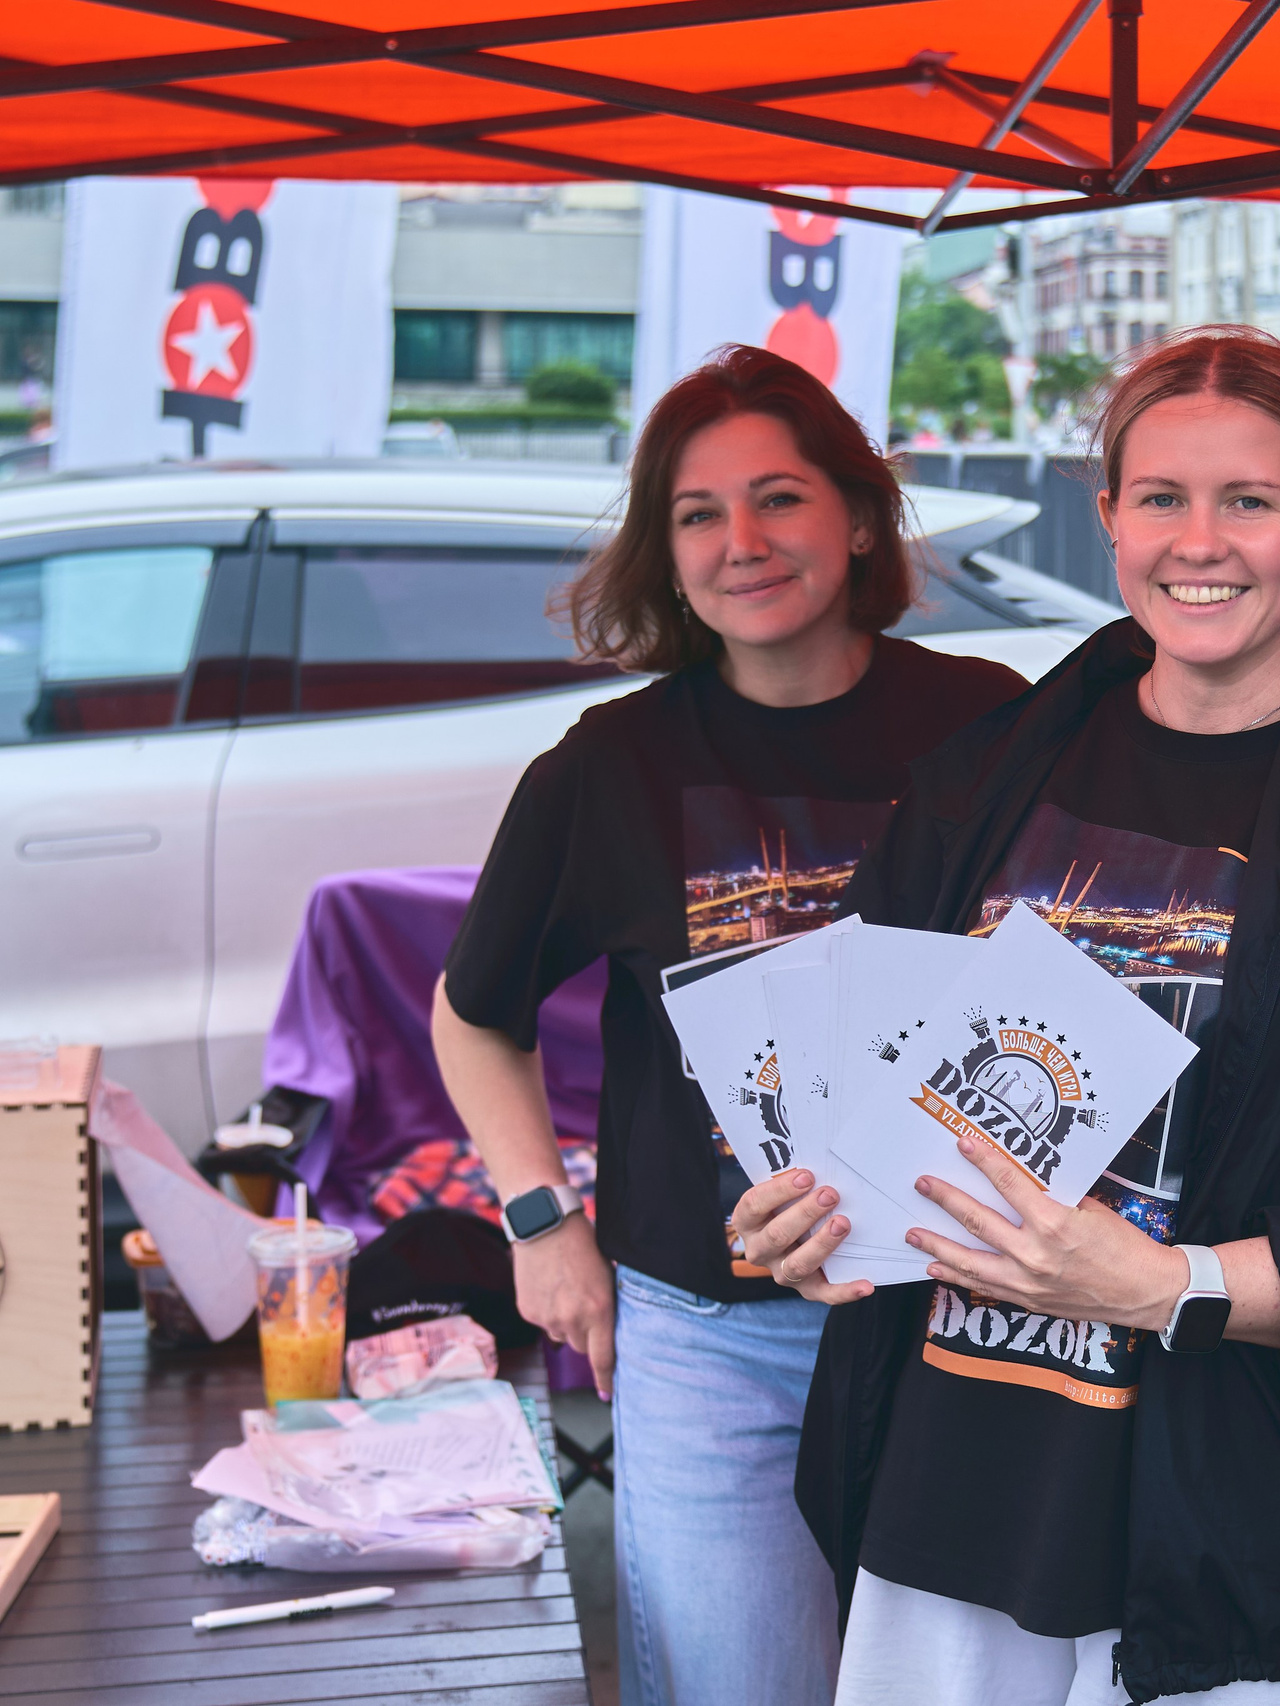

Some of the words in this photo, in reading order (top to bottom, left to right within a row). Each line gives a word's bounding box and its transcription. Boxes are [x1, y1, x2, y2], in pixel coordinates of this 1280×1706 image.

[1046, 1047, 1068, 1073] ЧЕМ
[1057, 1069, 1078, 1099] ИГРА
[926, 1058, 1061, 1185] DOZOR
